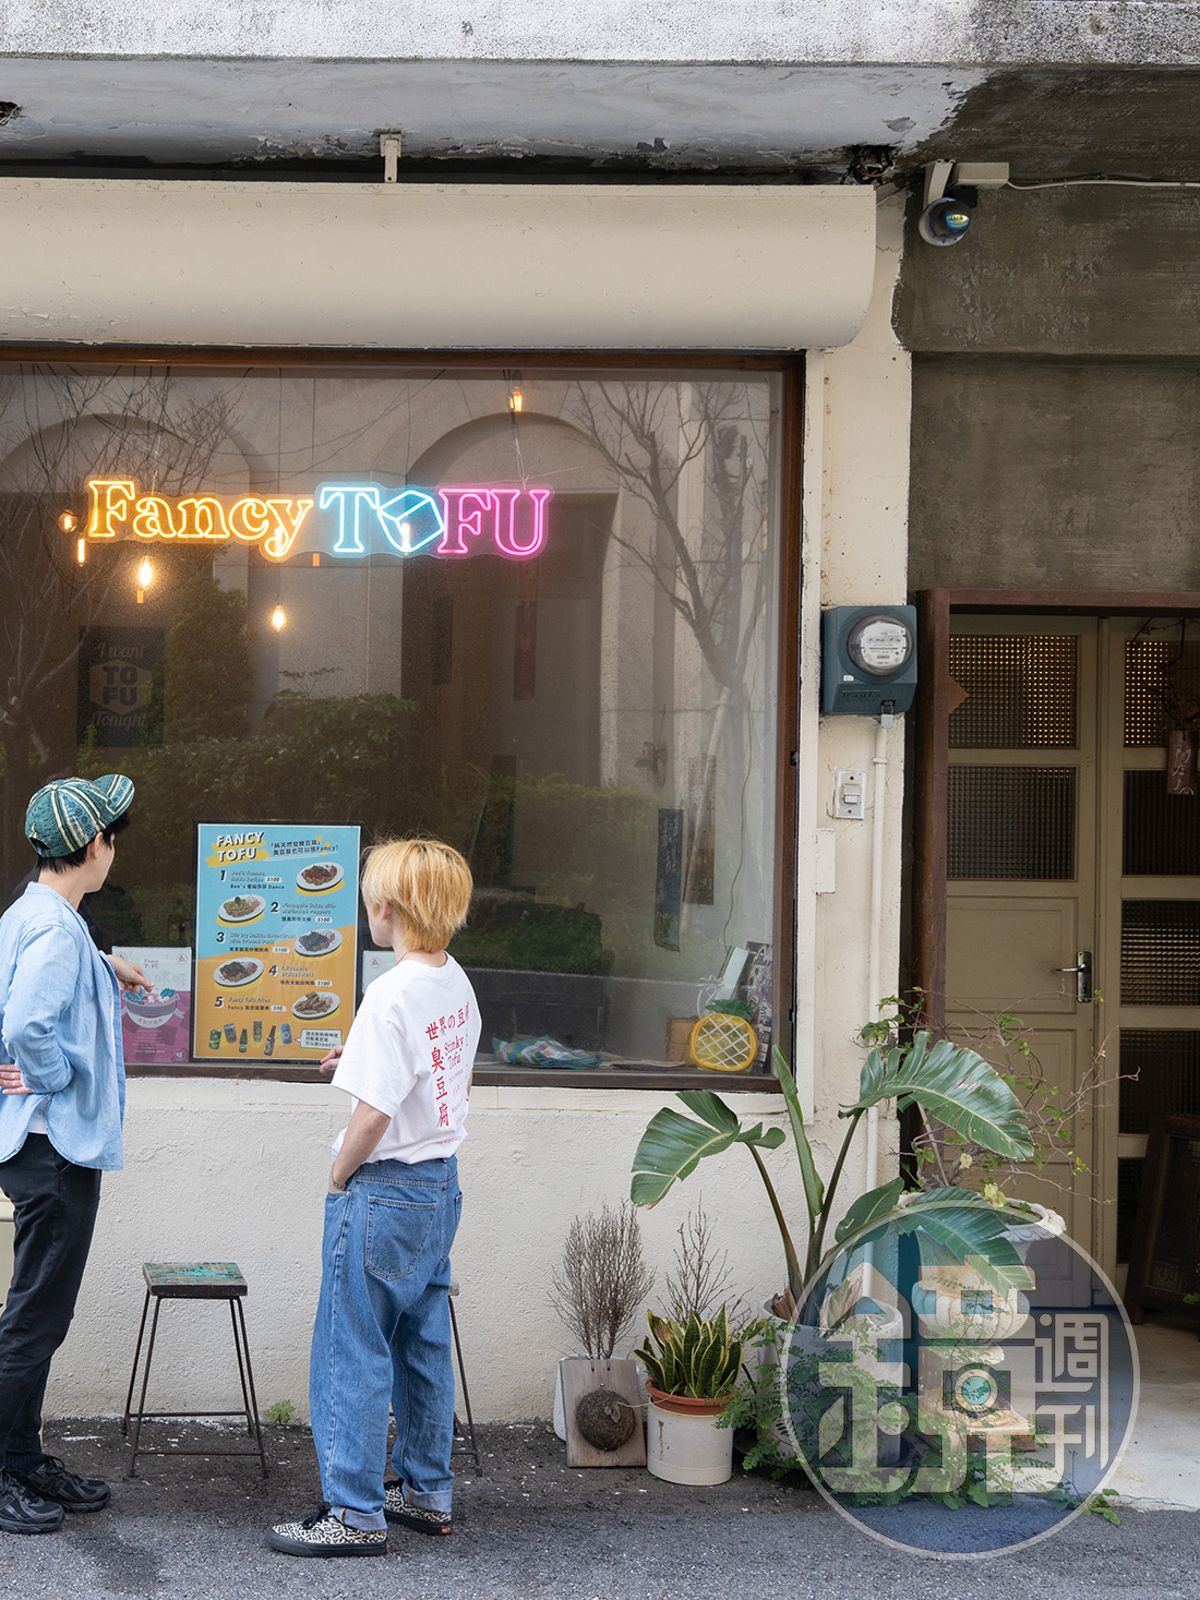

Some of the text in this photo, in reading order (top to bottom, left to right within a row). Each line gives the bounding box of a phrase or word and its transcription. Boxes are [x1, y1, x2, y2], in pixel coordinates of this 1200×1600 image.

[88, 480, 314, 558] Fancy
[108, 644, 145, 658] want
[102, 666, 138, 685] TO
[102, 686, 138, 705] FU
[92, 710, 147, 731] Tonight
[216, 831, 265, 847] FANCY
[217, 848, 257, 862] TOFU
[220, 870, 227, 881] 1
[271, 902, 279, 912] 2
[216, 932, 225, 943] 3
[269, 965, 277, 975] 4
[214, 996, 223, 1007] 5
[432, 1046, 449, 1127] 臭豆腐
